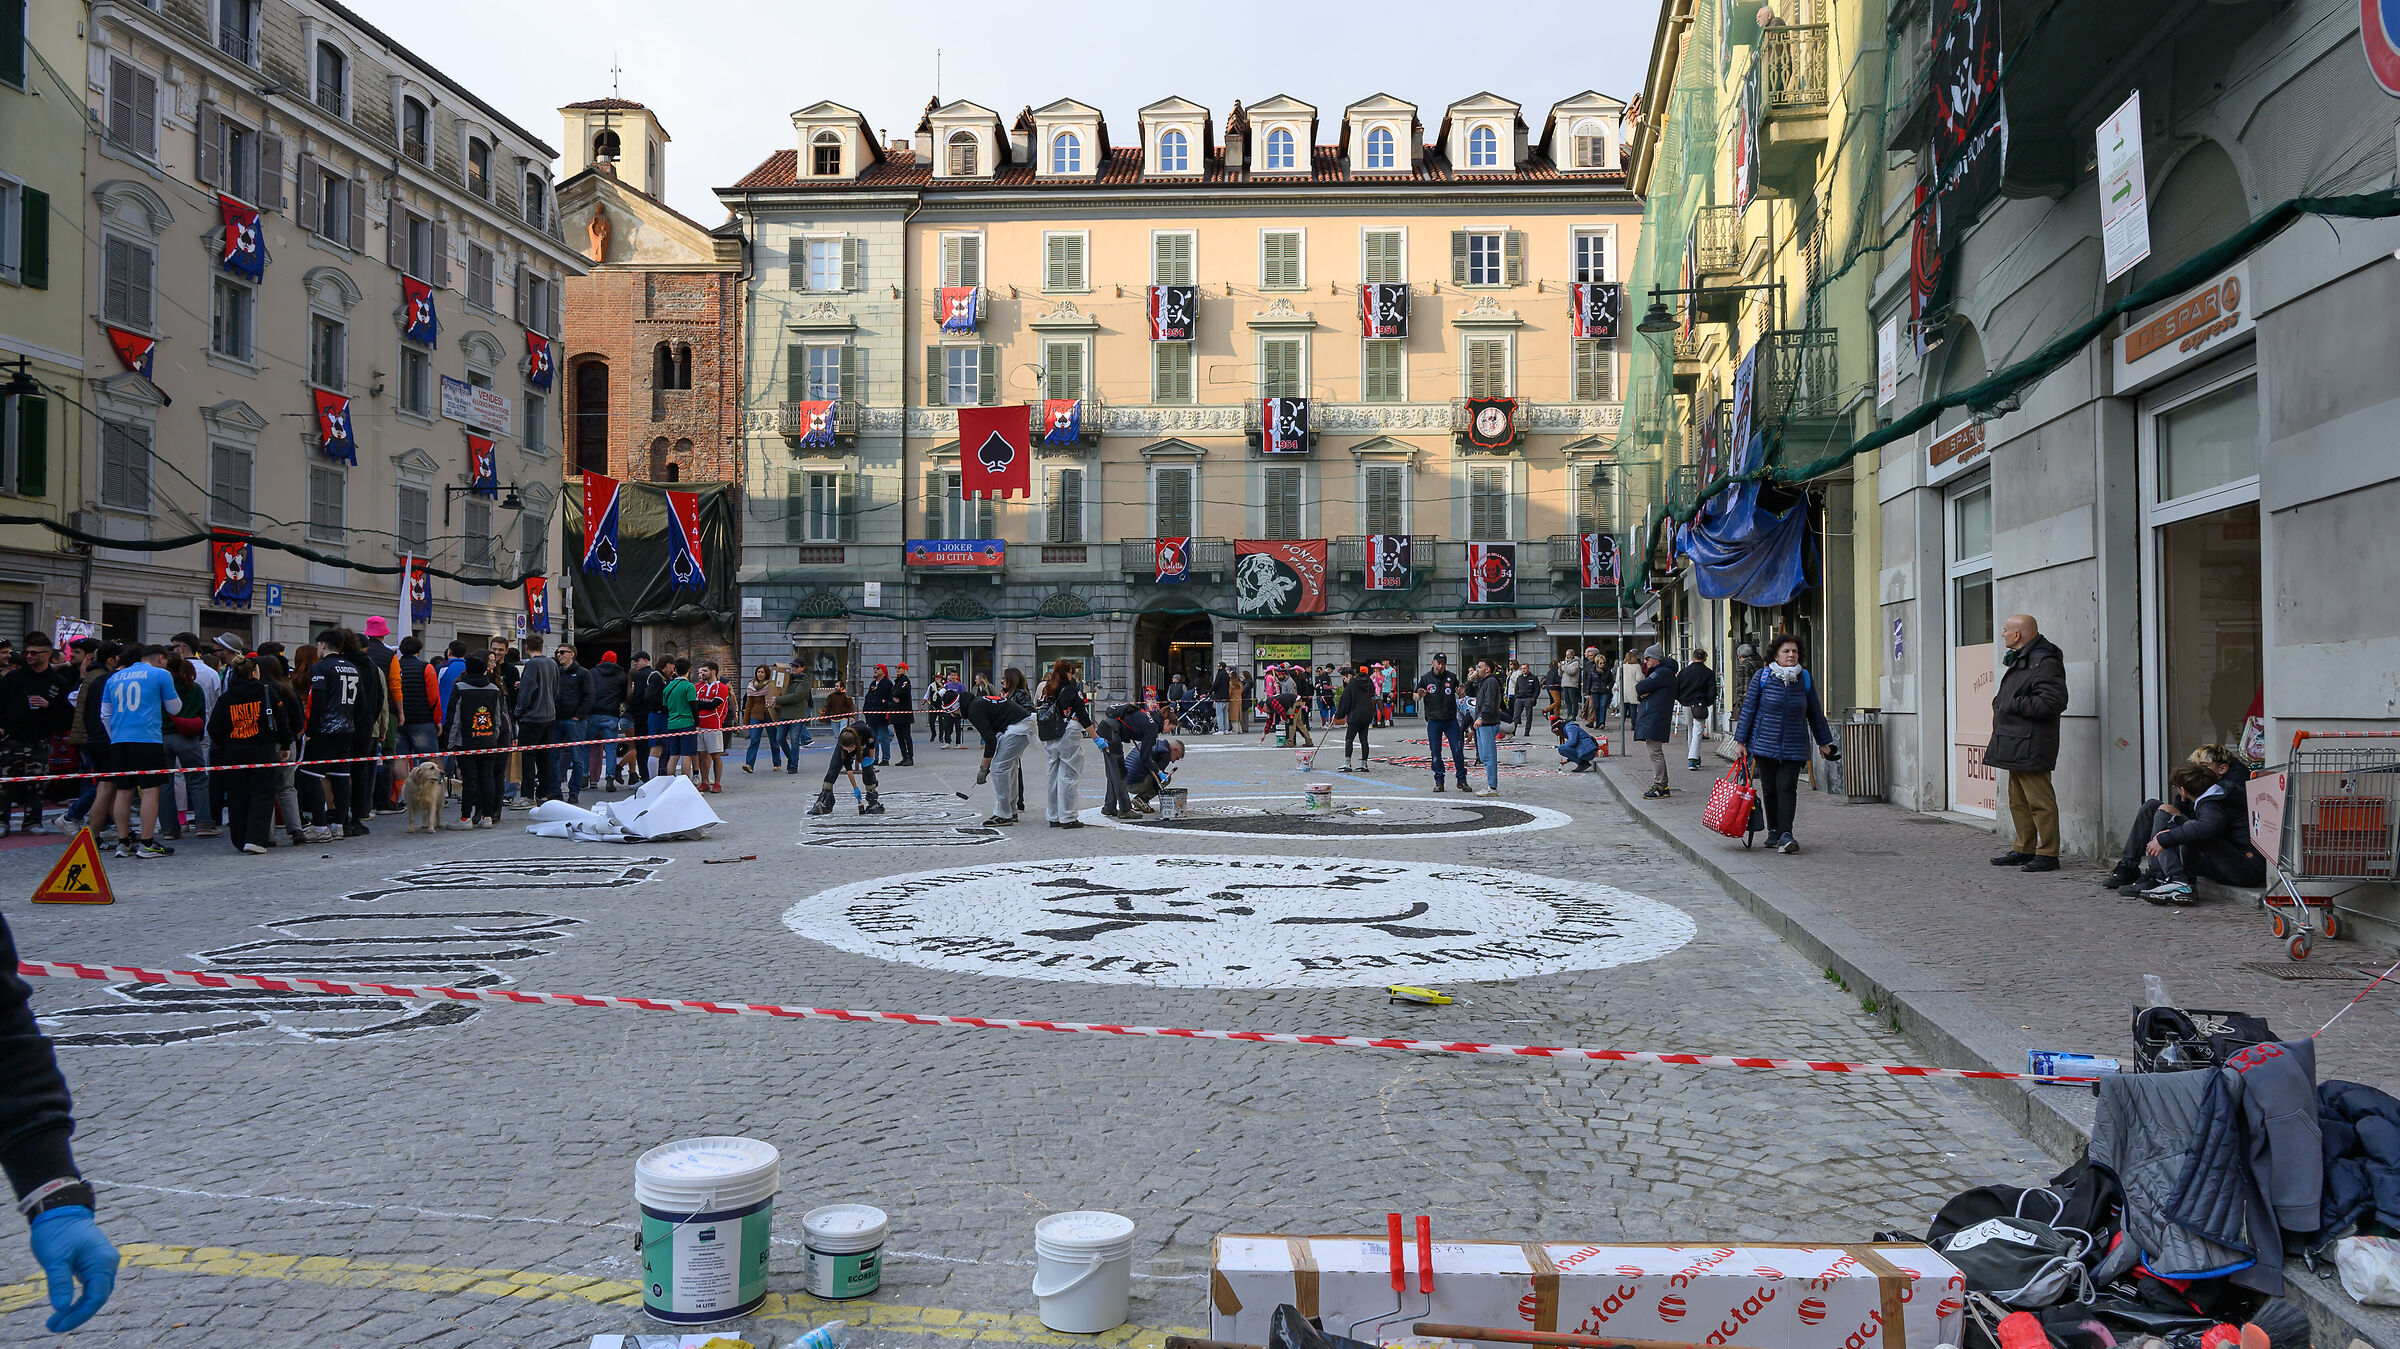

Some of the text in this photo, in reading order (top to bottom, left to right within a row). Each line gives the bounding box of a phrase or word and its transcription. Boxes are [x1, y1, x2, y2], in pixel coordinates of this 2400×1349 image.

[1375, 325, 1398, 334] 1954
[1585, 326, 1608, 334] 1954
[2138, 292, 2217, 350] DESPAR
[1162, 328, 1184, 337] 1954
[2178, 311, 2240, 352] express
[1275, 440, 1298, 449] 1954
[1937, 427, 1975, 458] DESPAR
[936, 551, 974, 561] DI CITTÀ
[937, 544, 973, 552] I JOKER
[1281, 544, 1324, 573] FONDO
[1288, 556, 1320, 596] PIAZZA
[1377, 577, 1401, 586] 1954
[1501, 569, 1512, 577] 54
[270, 586, 280, 604] P
[340, 675, 359, 705] 13
[1973, 671, 1988, 694] PIAZZA
[114, 682, 141, 713] 10
[230, 701, 261, 721] INSIEME
[875, 935, 1181, 974] Morte
